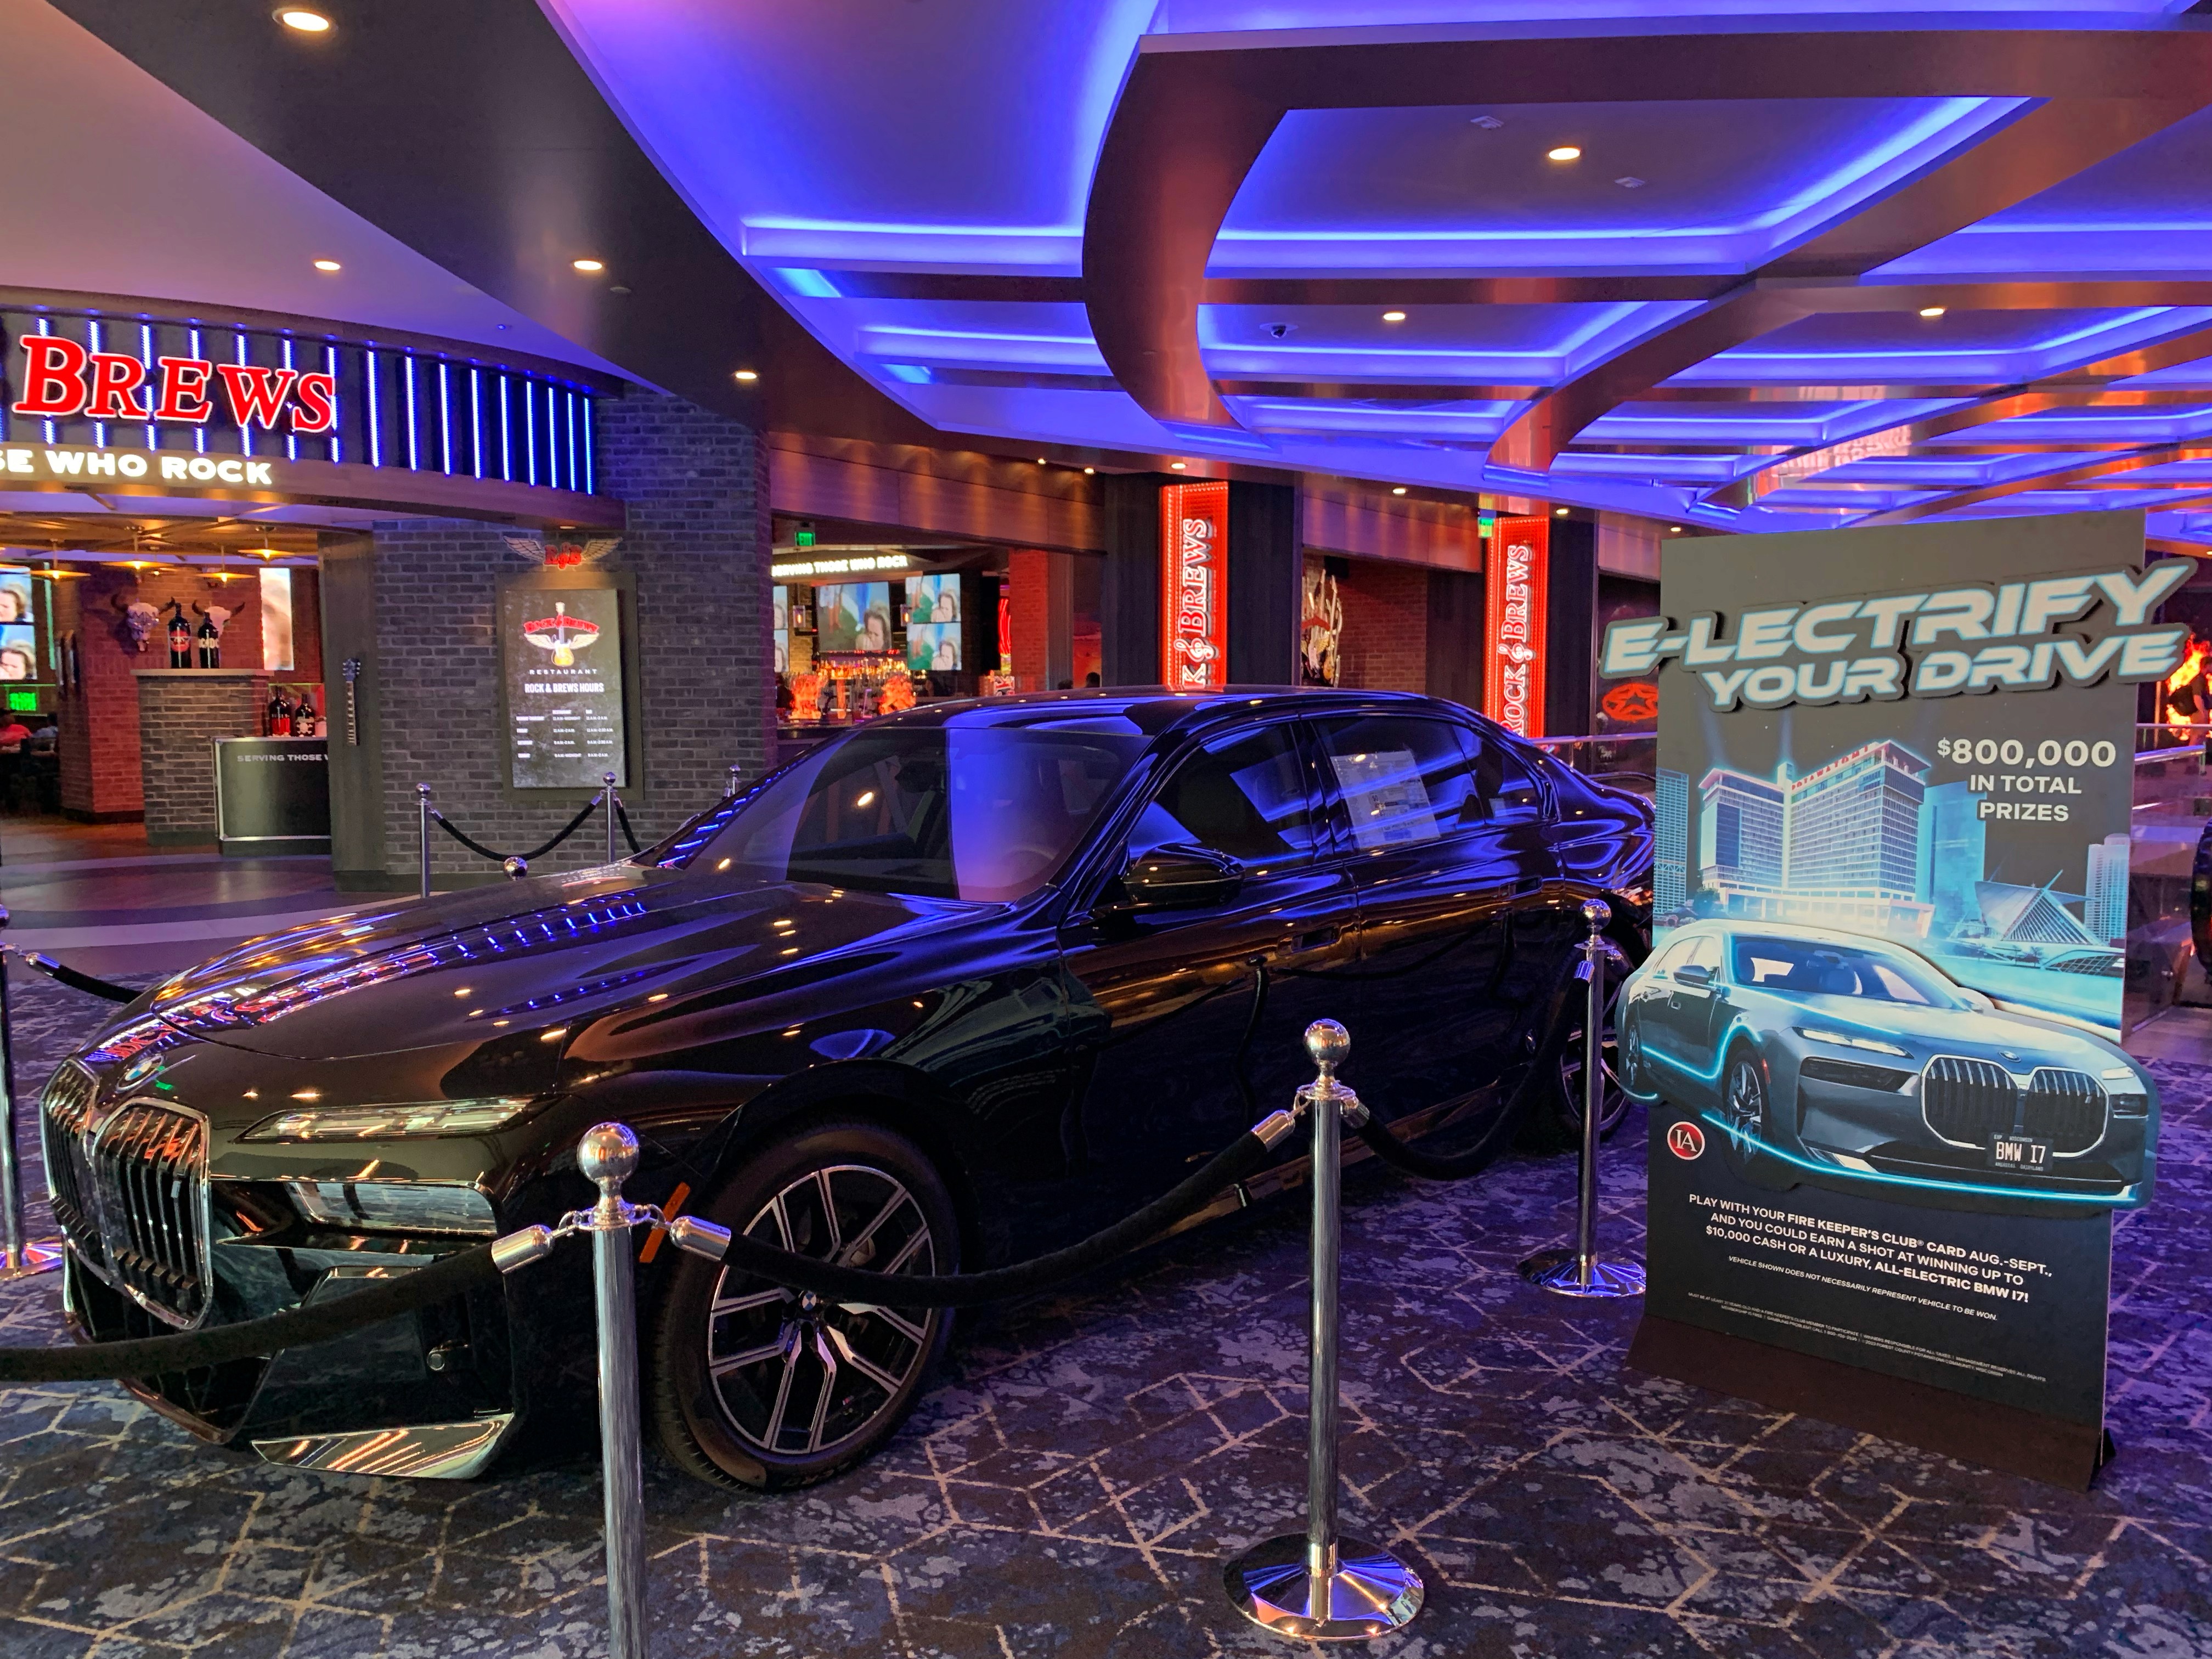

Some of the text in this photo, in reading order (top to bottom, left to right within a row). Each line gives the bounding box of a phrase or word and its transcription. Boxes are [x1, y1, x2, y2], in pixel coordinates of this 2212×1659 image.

[12, 334, 336, 433] BREWS
[45, 450, 147, 478] WHO
[161, 456, 272, 484] ROCK
[849, 557, 876, 570] WHO
[1178, 518, 1207, 637] BREWS
[1501, 545, 1528, 642] BREWS
[1604, 565, 2190, 673] E-LECTRIFY
[524, 683, 545, 693] ROCK
[553, 683, 579, 693] BREWS
[580, 682, 605, 692] HOURS
[1702, 630, 2183, 706] YOUR DRIVE
[1937, 737, 2116, 769] $800,000
[1970, 775, 2082, 794] IN TOTAL
[1979, 802, 2069, 821] PRIZES
[1996, 1142, 2023, 1162] BMW
[1690, 1194, 1717, 1207] PLAY
[1720, 1200, 1750, 1214] WITH
[1752, 1206, 1785, 1221] YOUR
[1788, 1214, 1815, 1227] FIRE
[1818, 1220, 1879, 1240] KEEPER'S
[1927, 1242, 1966, 1257] CARD
[1711, 1213, 2023, 1285] AND YOU COULD EARN A SHOT AT WINNING UP TO
[1706, 1225, 1750, 1242] $10,000
[1753, 1236, 1786, 1250] CASH
[1788, 1243, 1806, 1255] OR
[1809, 1248, 1818, 1257] A
[1821, 1250, 1871, 1270] LUXURY,
[1875, 1262, 1971, 1290] ALL-ELECTRIC
[1974, 1282, 2009, 1298] BMW
[1729, 1256, 1757, 1267] VEHICLE
[1758, 1262, 1784, 1272] SHOWN
[1785, 1268, 1804, 1277] DOES
[1821, 1277, 1871, 1291] NECESSARILY
[1872, 1288, 1917, 1302] REPRESENT
[1918, 1298, 1951, 1310] VEHICLE
